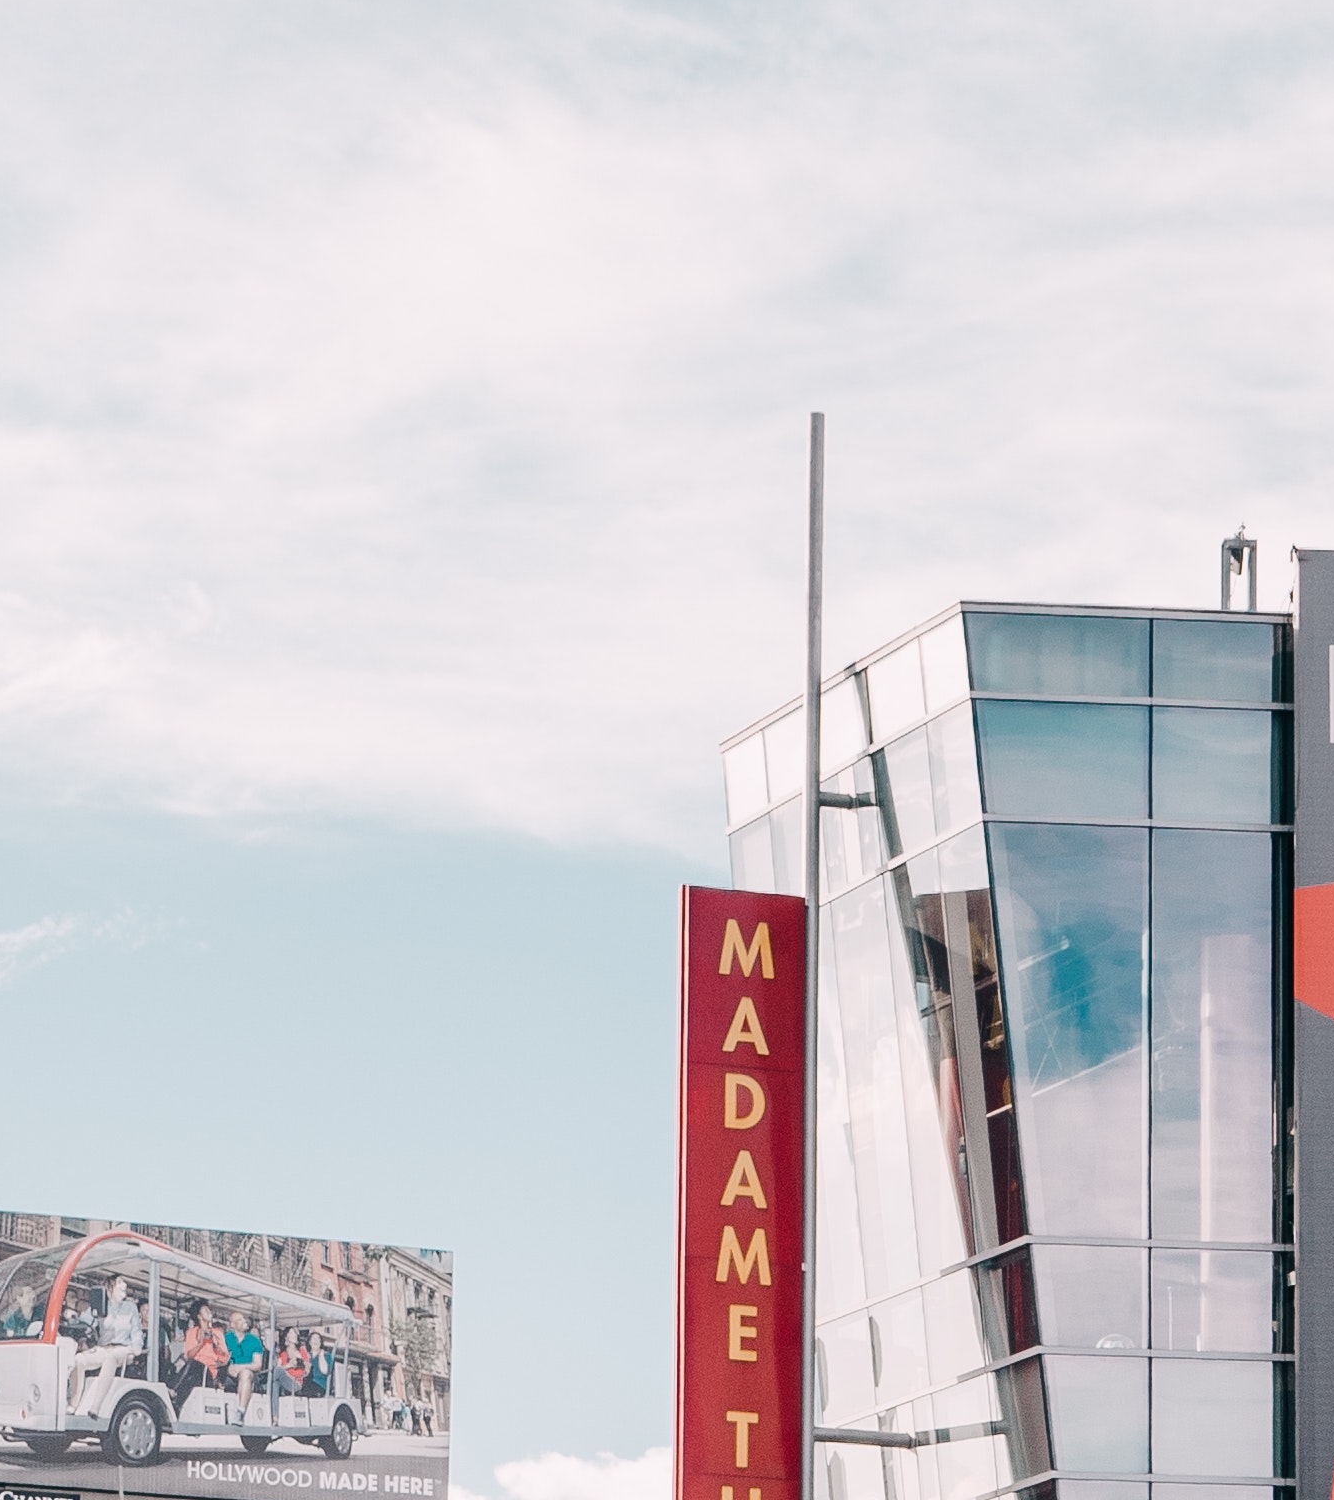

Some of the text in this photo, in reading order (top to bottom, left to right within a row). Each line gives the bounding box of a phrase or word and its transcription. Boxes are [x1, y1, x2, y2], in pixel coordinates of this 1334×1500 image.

[714, 917, 775, 1362] MADAME
[187, 1460, 434, 1497] HOLLYWOOD MADE HERE
